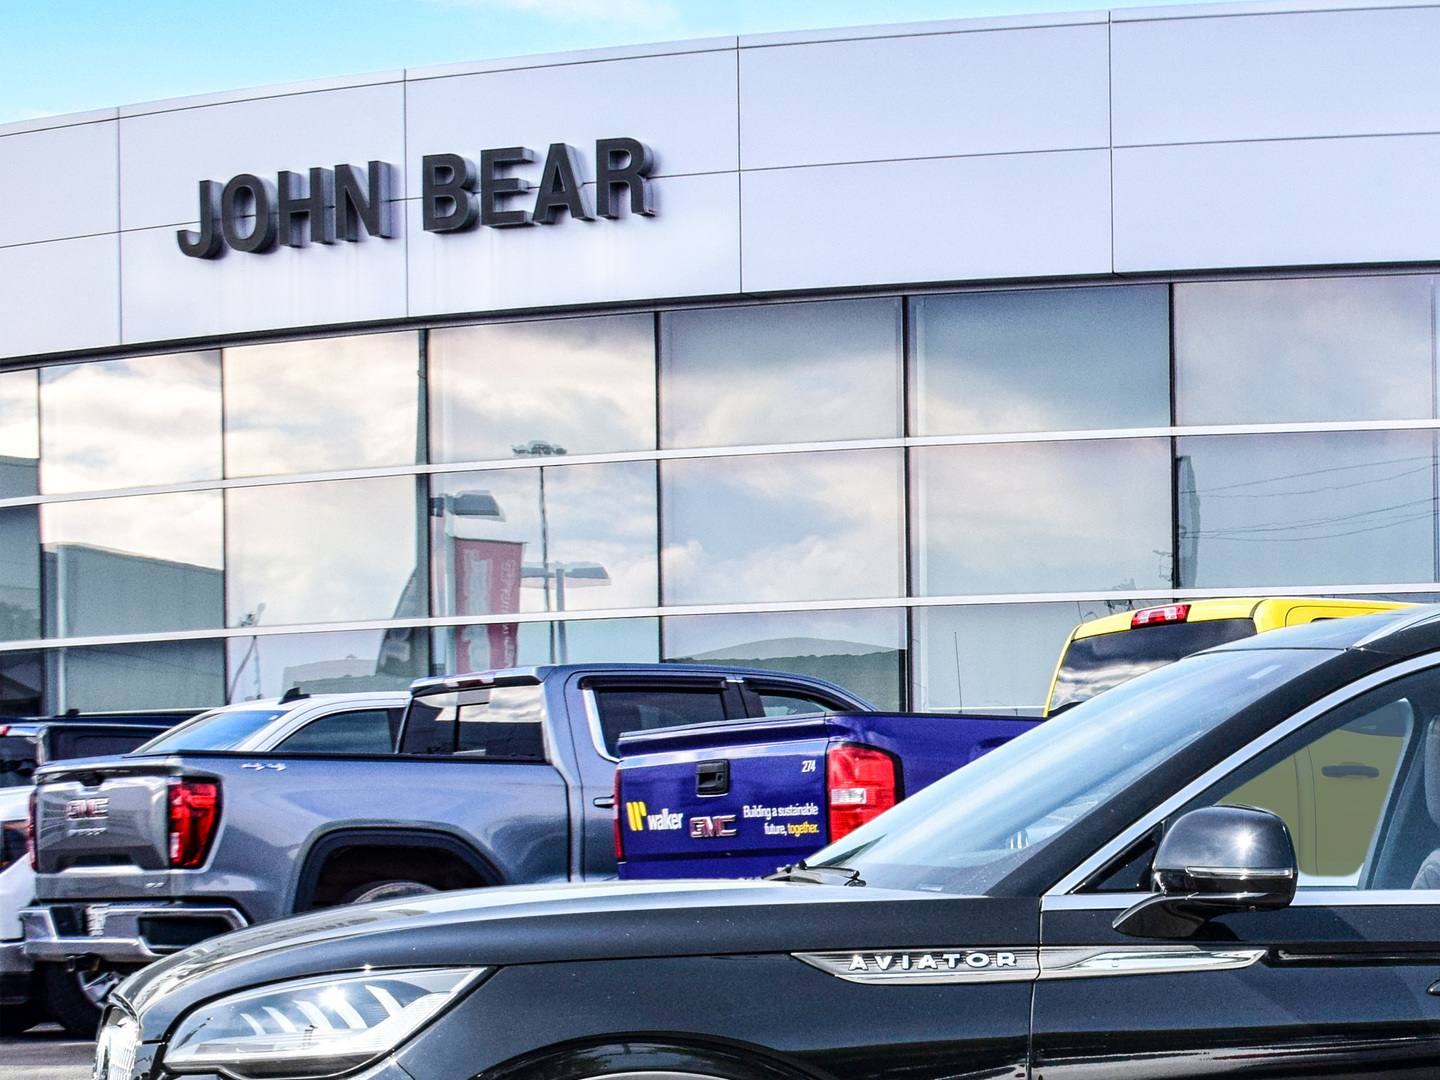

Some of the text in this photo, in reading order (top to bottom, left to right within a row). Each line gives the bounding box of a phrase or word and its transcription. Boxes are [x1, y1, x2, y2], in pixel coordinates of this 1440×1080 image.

[177, 137, 656, 260] JOHN BEAR
[801, 760, 816, 773] 274
[647, 808, 683, 830] walker
[743, 803, 819, 820] Building a sustainable
[689, 814, 737, 838] GMC
[764, 821, 819, 837] future, together.
[849, 952, 1017, 971] AVIATOR
